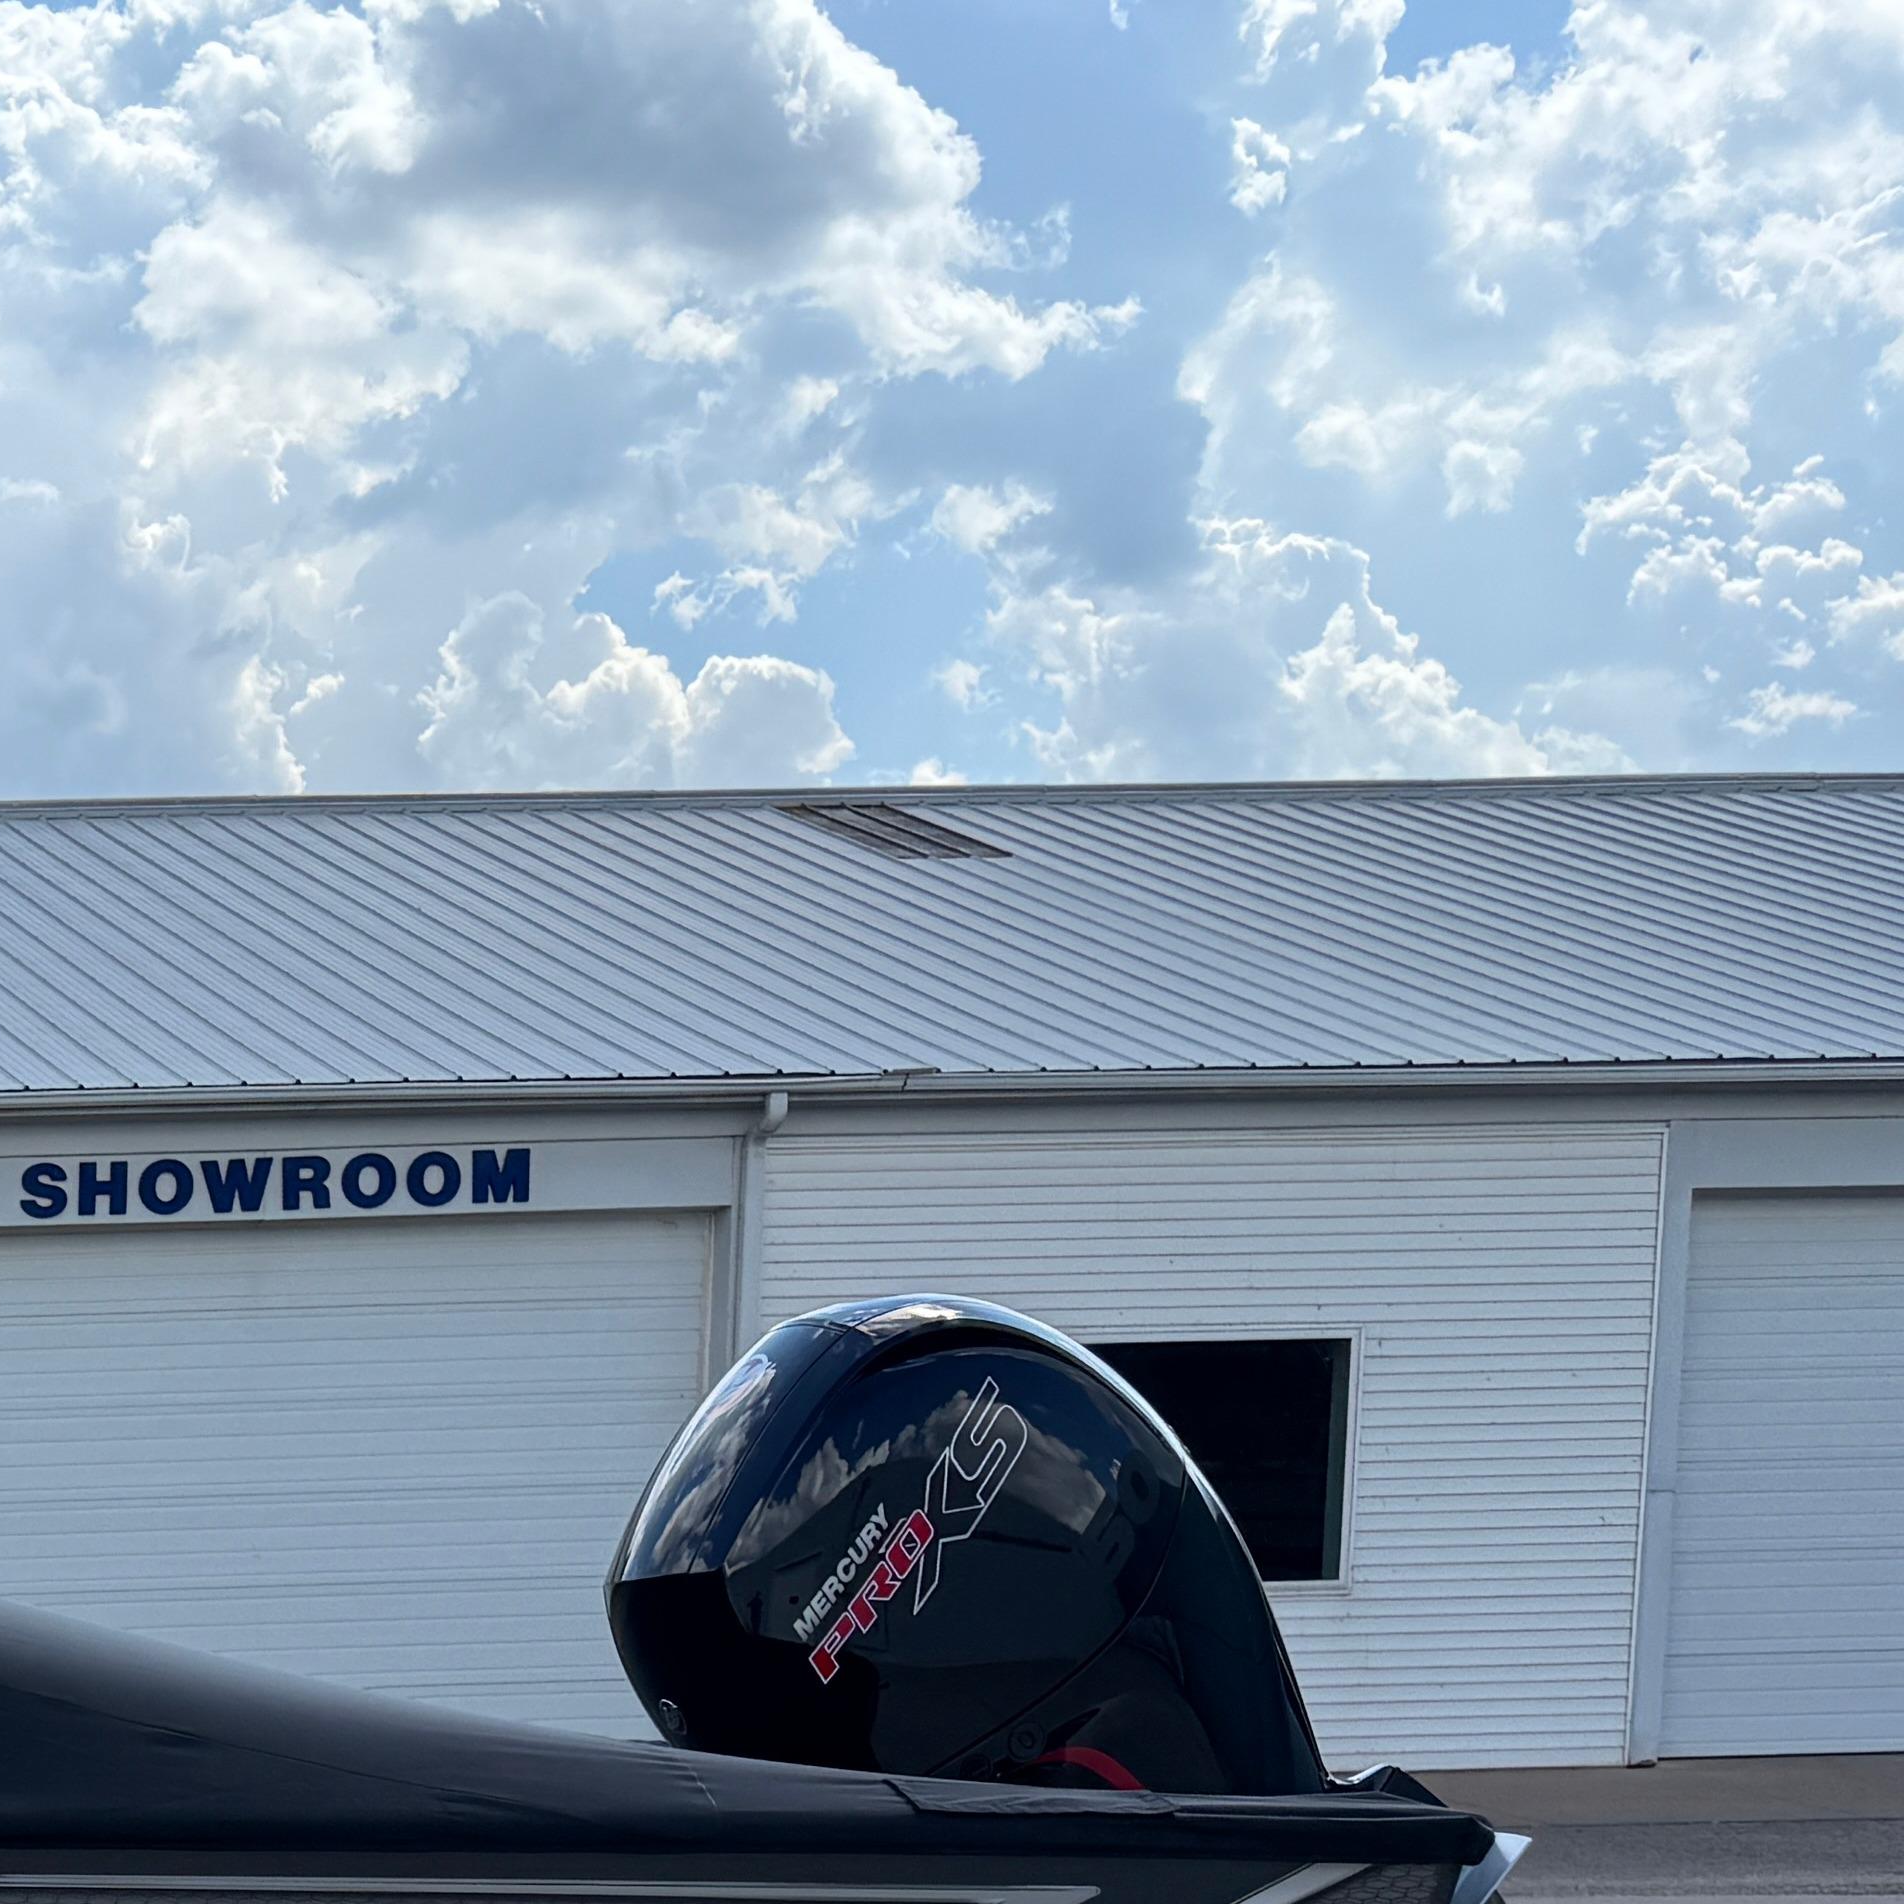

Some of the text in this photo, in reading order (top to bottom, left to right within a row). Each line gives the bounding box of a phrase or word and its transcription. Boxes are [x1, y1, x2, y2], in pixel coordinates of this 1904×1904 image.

[19, 1148, 531, 1219] SHOWROOM
[793, 1502, 889, 1642] MERCURY
[808, 1376, 1028, 1685] PRO XS
